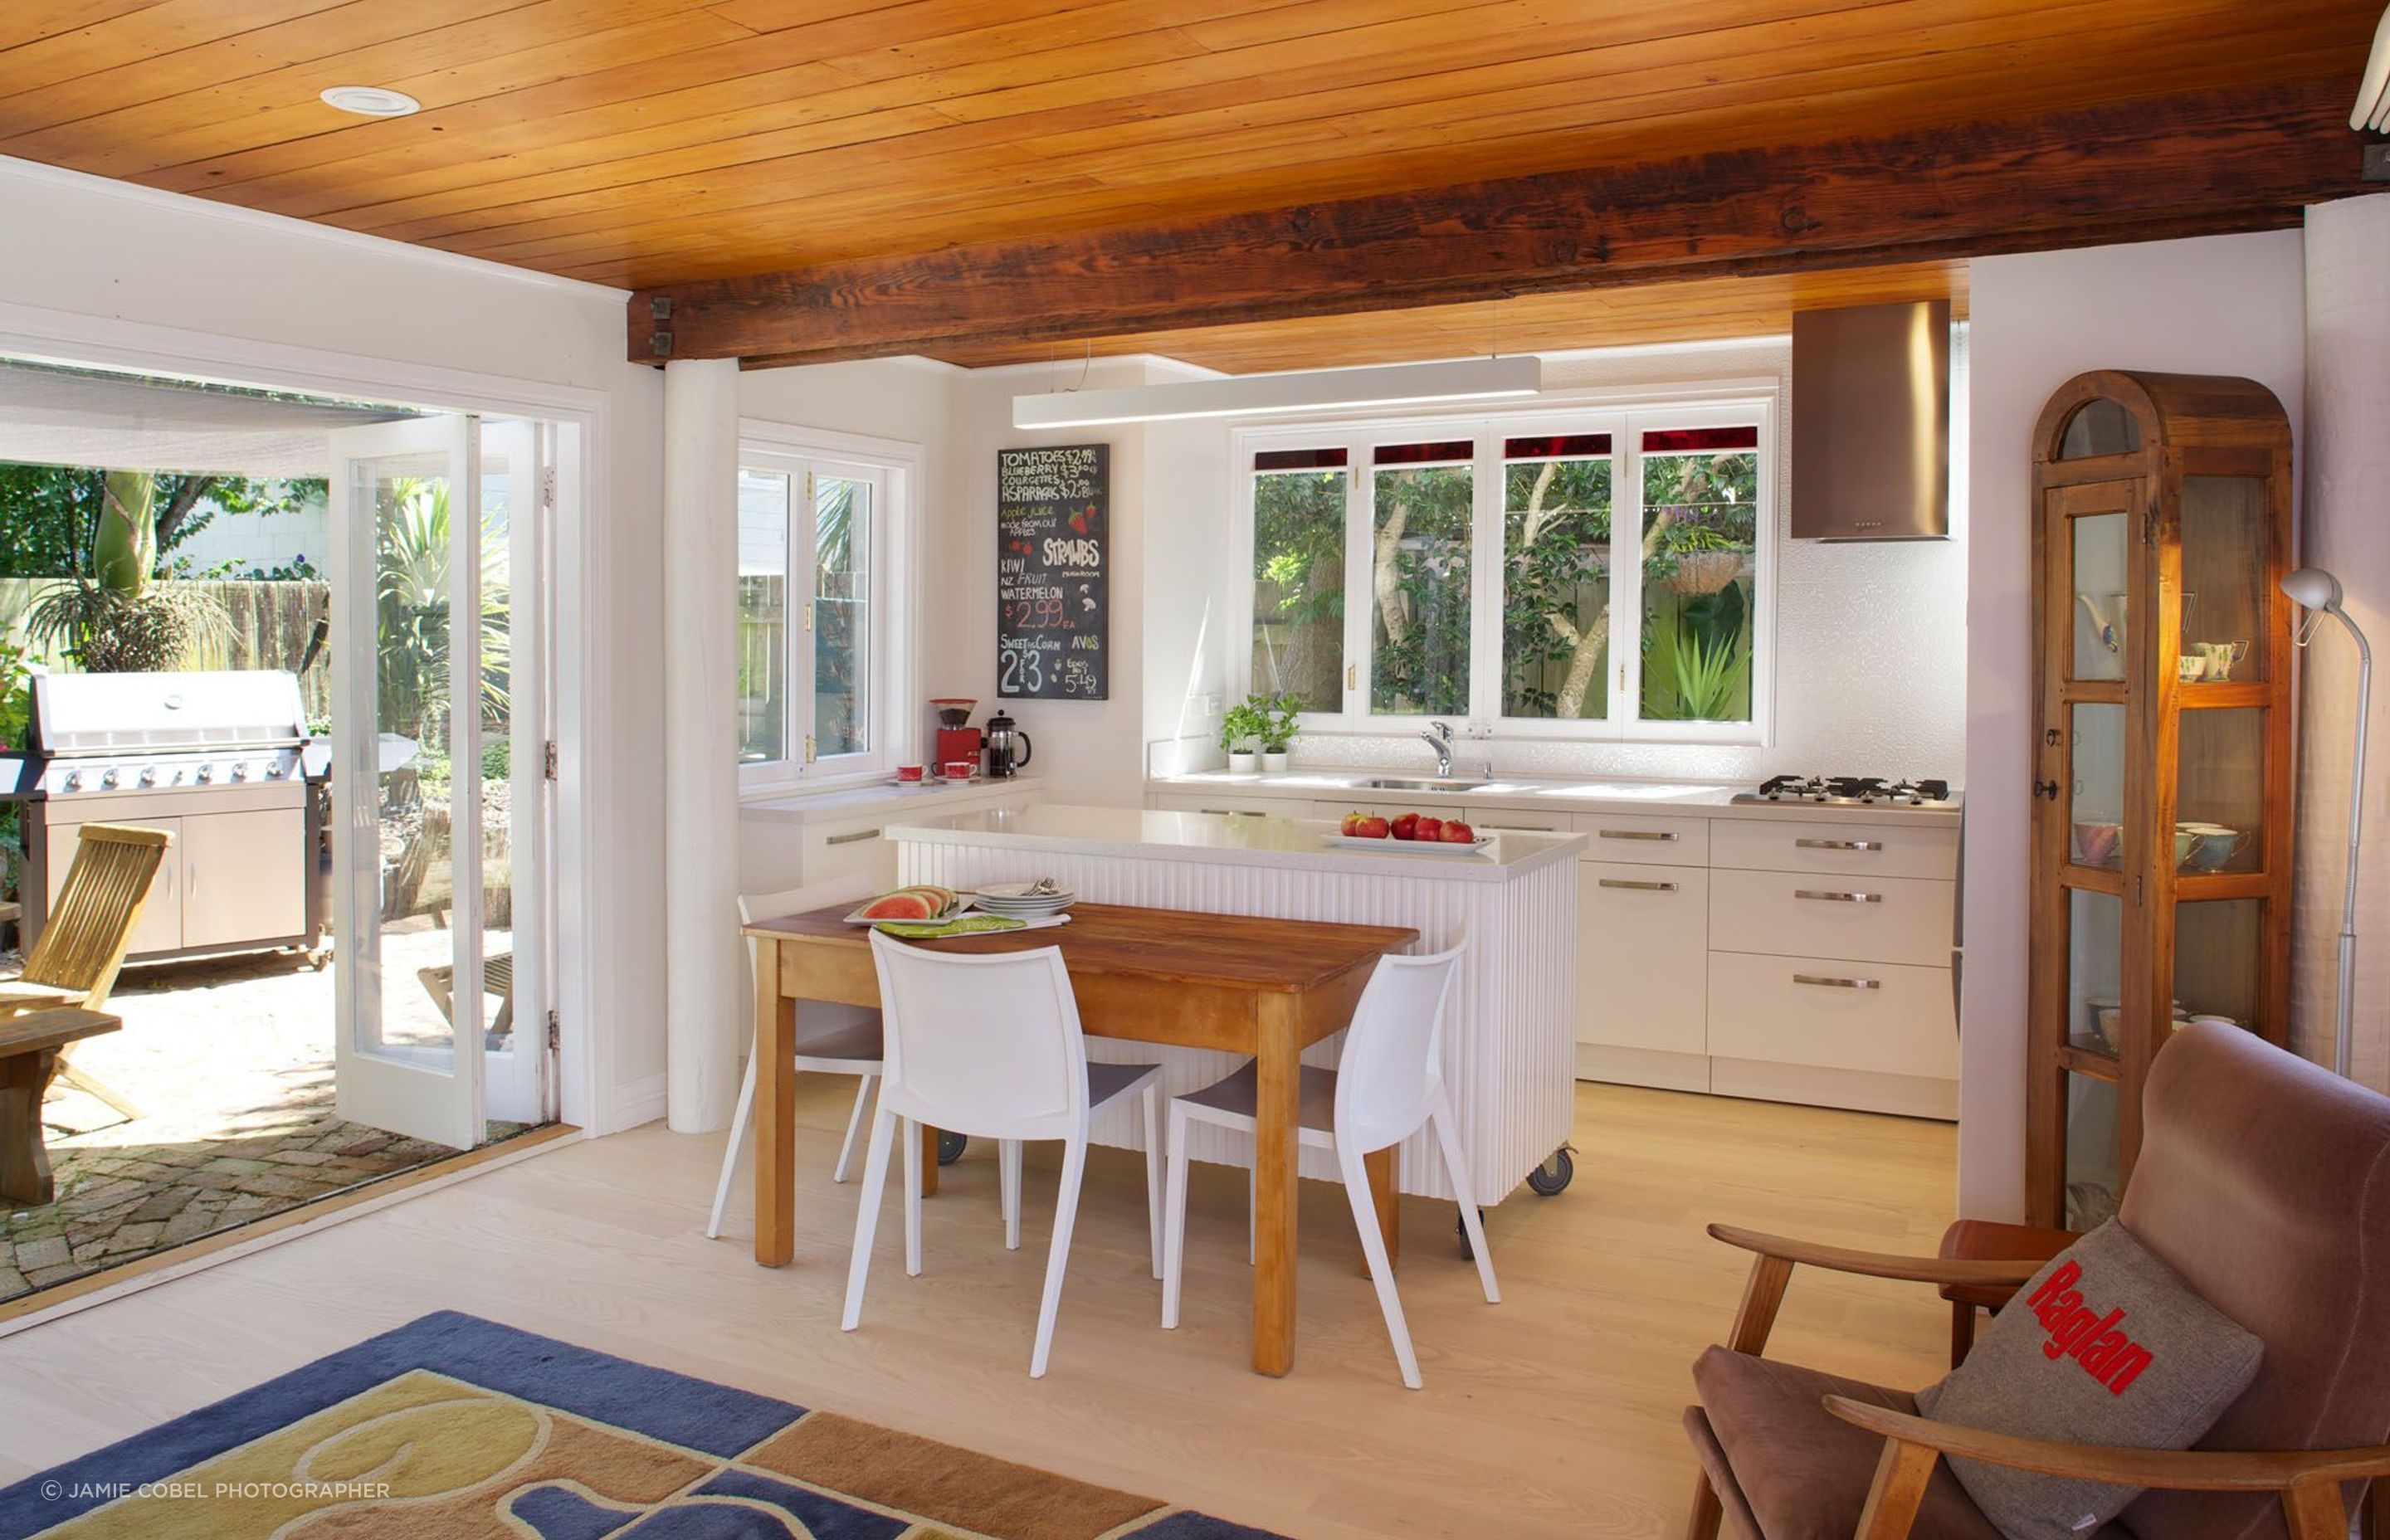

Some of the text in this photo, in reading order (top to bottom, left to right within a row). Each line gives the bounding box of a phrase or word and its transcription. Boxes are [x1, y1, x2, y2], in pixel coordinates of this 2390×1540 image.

[1001, 451, 1066, 467] TOMATOES
[1001, 464, 1058, 476] BLUEBERRY
[1002, 475, 1060, 485] COURGETTES
[1042, 538, 1100, 567] STRAWBS
[1001, 558, 1025, 573] KIWI
[1001, 578, 1014, 586] NZ
[1017, 573, 1047, 585] FRUIT
[1001, 587, 1063, 600] WATERMELON
[1063, 621, 1076, 629] EA
[1000, 650, 1020, 693] 2
[2027, 1260, 2154, 1396] Raglan
